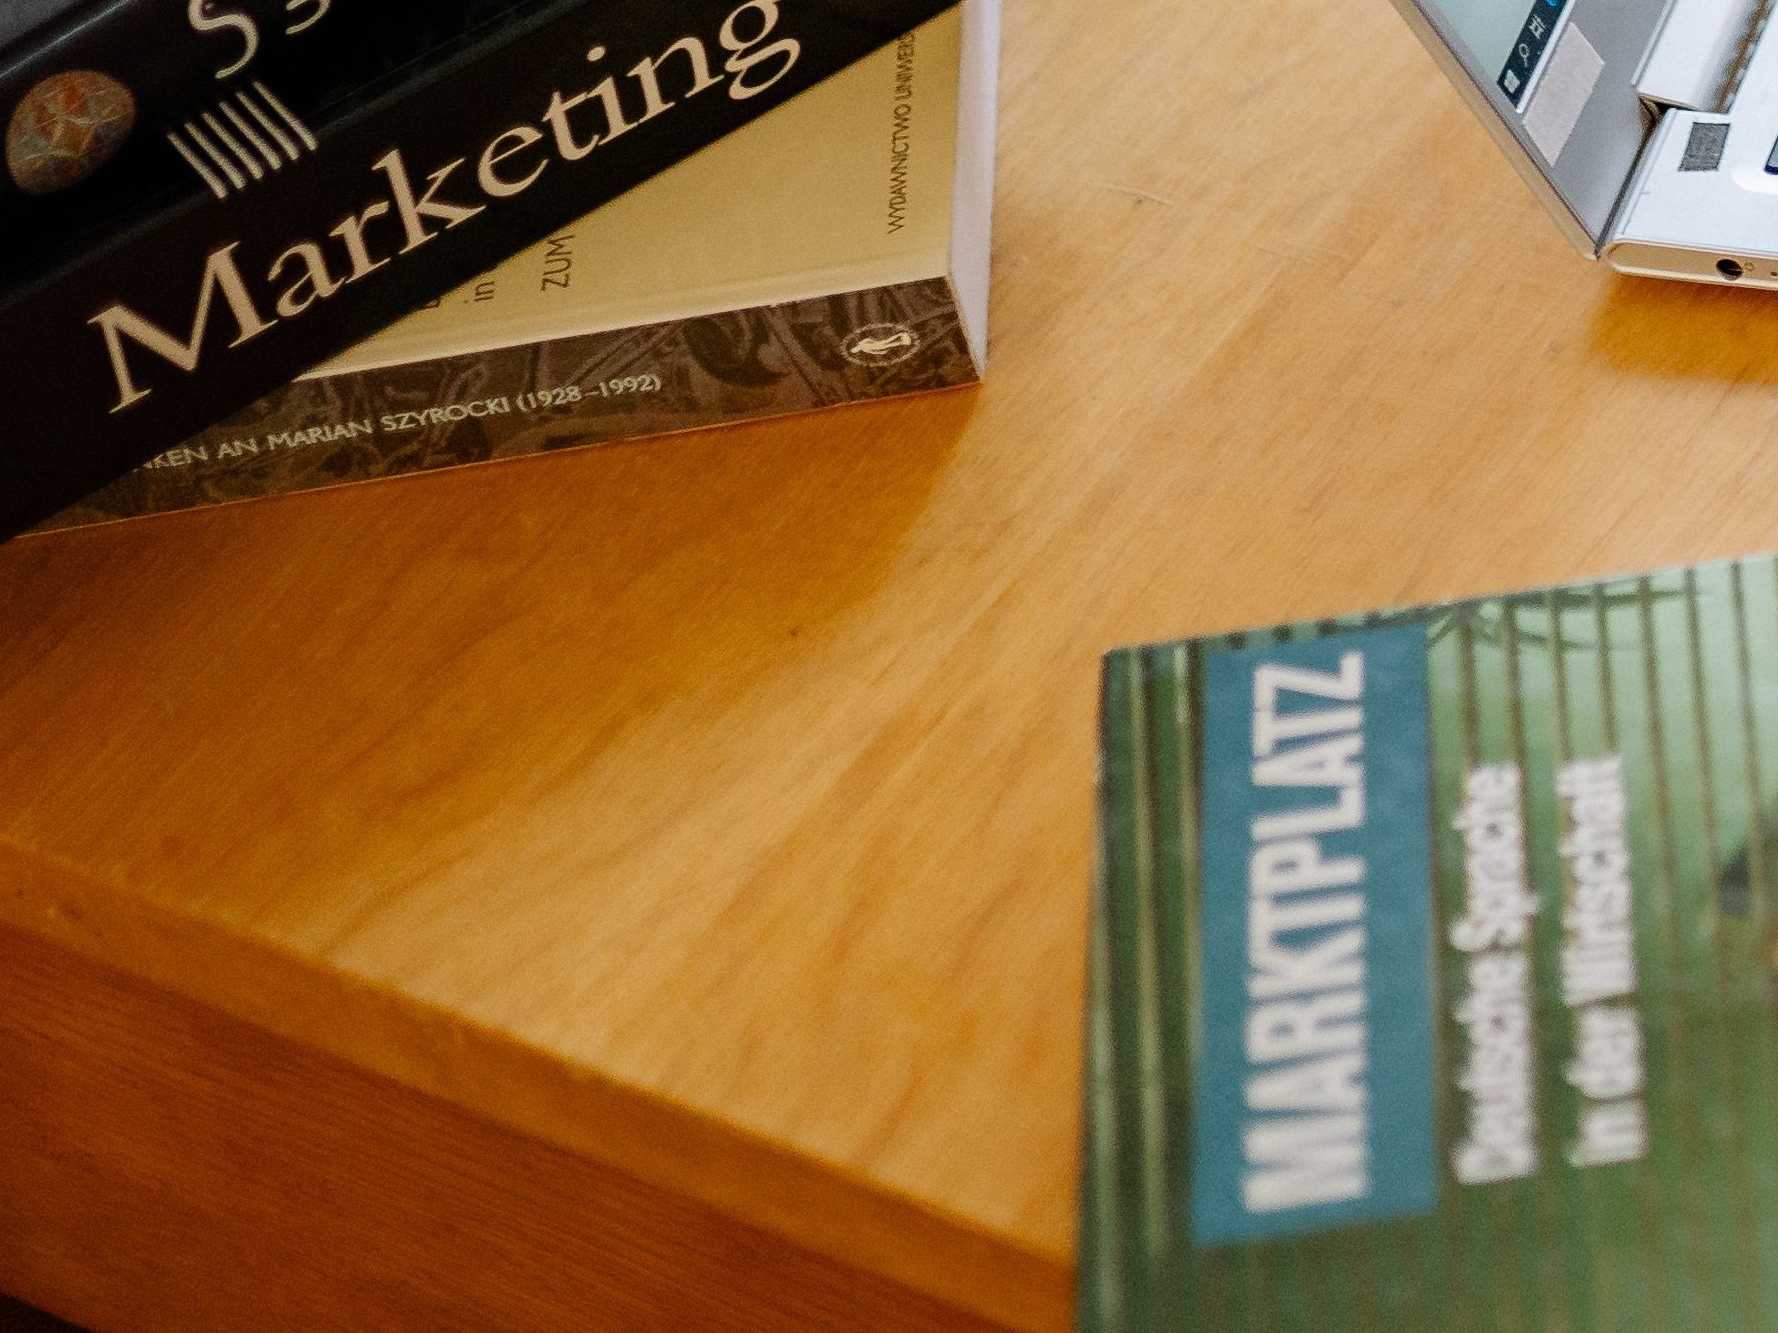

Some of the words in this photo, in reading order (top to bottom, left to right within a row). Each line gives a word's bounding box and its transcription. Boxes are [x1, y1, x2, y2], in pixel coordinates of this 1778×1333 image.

[887, 103, 912, 234] WYDAWNICTWO
[540, 234, 575, 292] ZUM
[217, 437, 259, 460] AN
[267, 419, 374, 451] MARIAN
[380, 395, 511, 432] SZYROCKI
[1449, 761, 1541, 953] Sprache
[1240, 650, 1370, 1215] MARKTPLATZ
